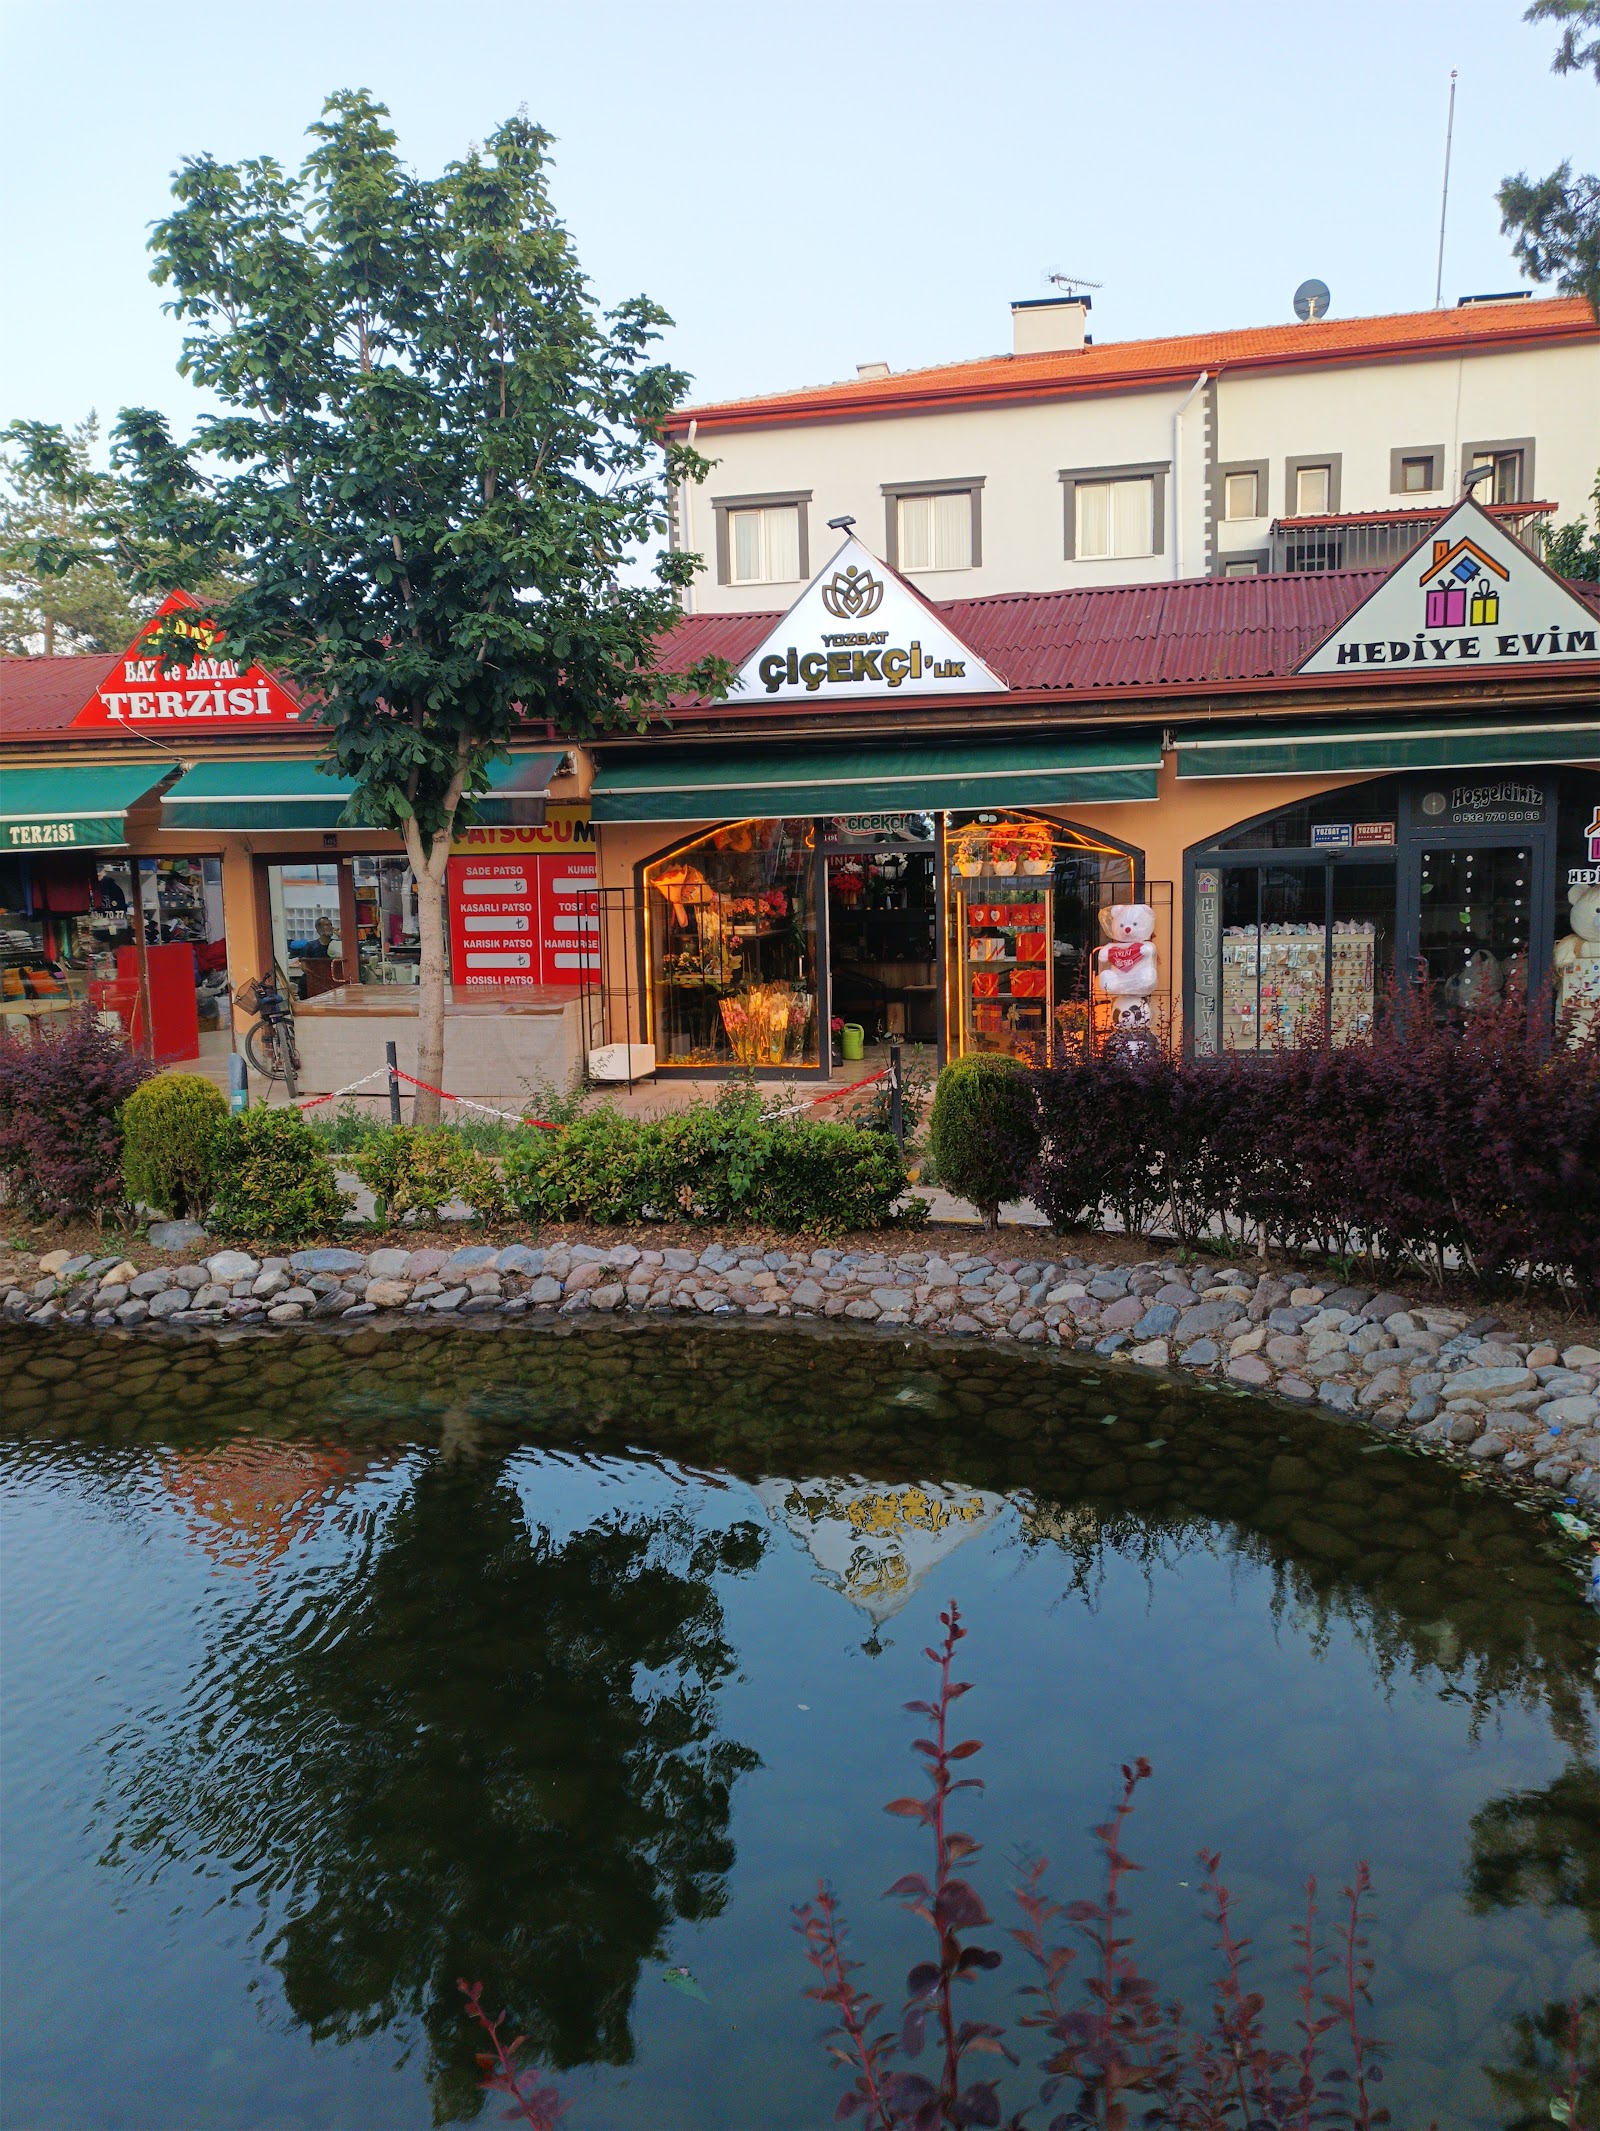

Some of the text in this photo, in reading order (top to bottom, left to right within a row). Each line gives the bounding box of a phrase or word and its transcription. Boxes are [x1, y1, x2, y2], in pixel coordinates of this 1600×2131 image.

[821, 631, 889, 647] YOZGAT
[1336, 625, 1599, 665] HEDİYE EVİM
[124, 660, 157, 683] BAY
[101, 679, 272, 719] TERZİSİ
[1453, 811, 1540, 822] 0 532 770 90 66
[457, 820, 596, 844] ATSOCUM
[466, 866, 523, 875] SADE PATSO
[568, 865, 597, 875] KUMR
[460, 903, 532, 912] KASARLI PATSO
[558, 903, 583, 911] TOST
[463, 939, 533, 948] KARISIK PATSO
[544, 940, 600, 948] HAMBURGE
[1201, 897, 1215, 987] HEDİYE
[465, 976, 534, 985] SOSISLI PATSO
